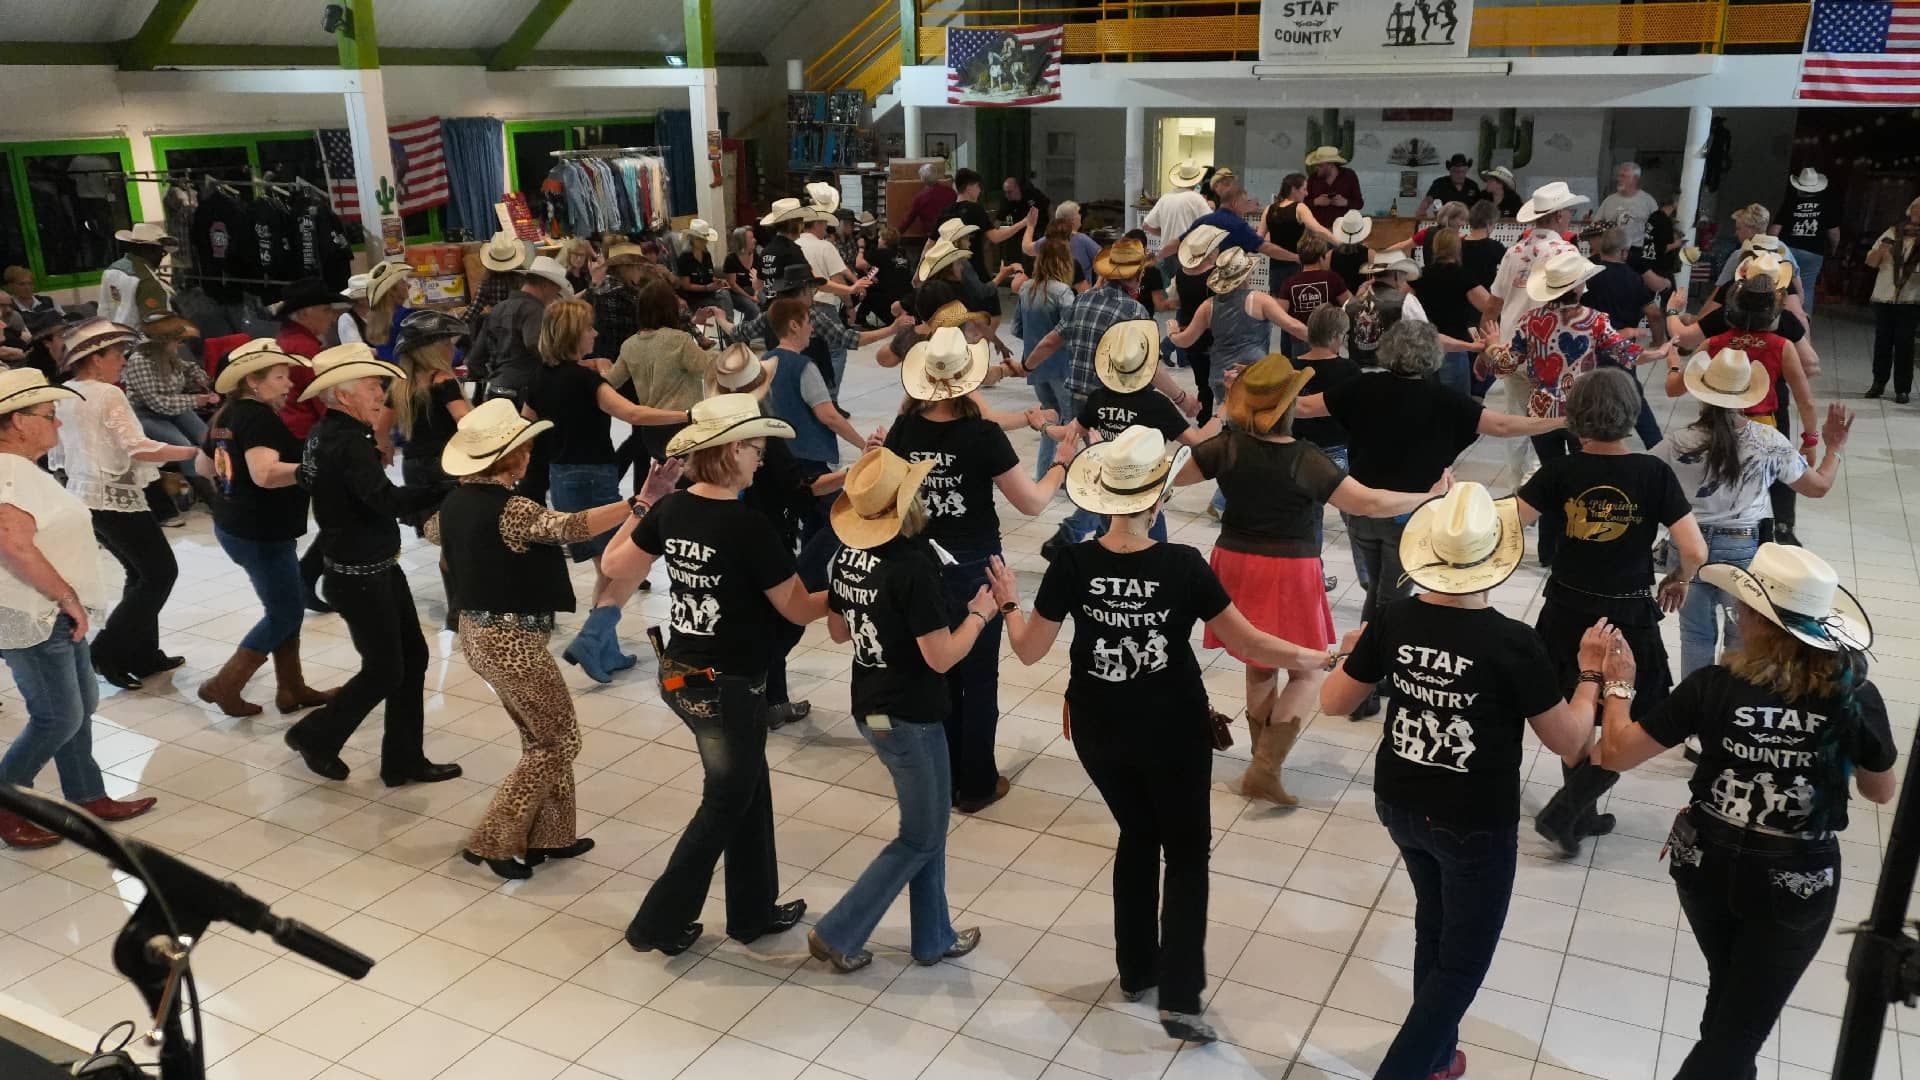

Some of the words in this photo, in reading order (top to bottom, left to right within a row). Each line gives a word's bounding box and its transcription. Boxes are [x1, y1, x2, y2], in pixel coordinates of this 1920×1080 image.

[1283, 0, 1339, 17] STAF
[1274, 26, 1343, 45] COUNTRY
[1097, 407, 1137, 422] STAF
[909, 451, 957, 466] STAF
[922, 474, 963, 488] UNTRY
[665, 538, 717, 562] STAF
[838, 548, 881, 573] STAF
[833, 579, 878, 605] OUNTRY
[1088, 577, 1160, 597] STAF
[1082, 604, 1170, 629] COUNTRY
[1396, 644, 1474, 676] STAF
[1393, 672, 1479, 709] COUNTRY
[1732, 706, 1828, 733] STAF
